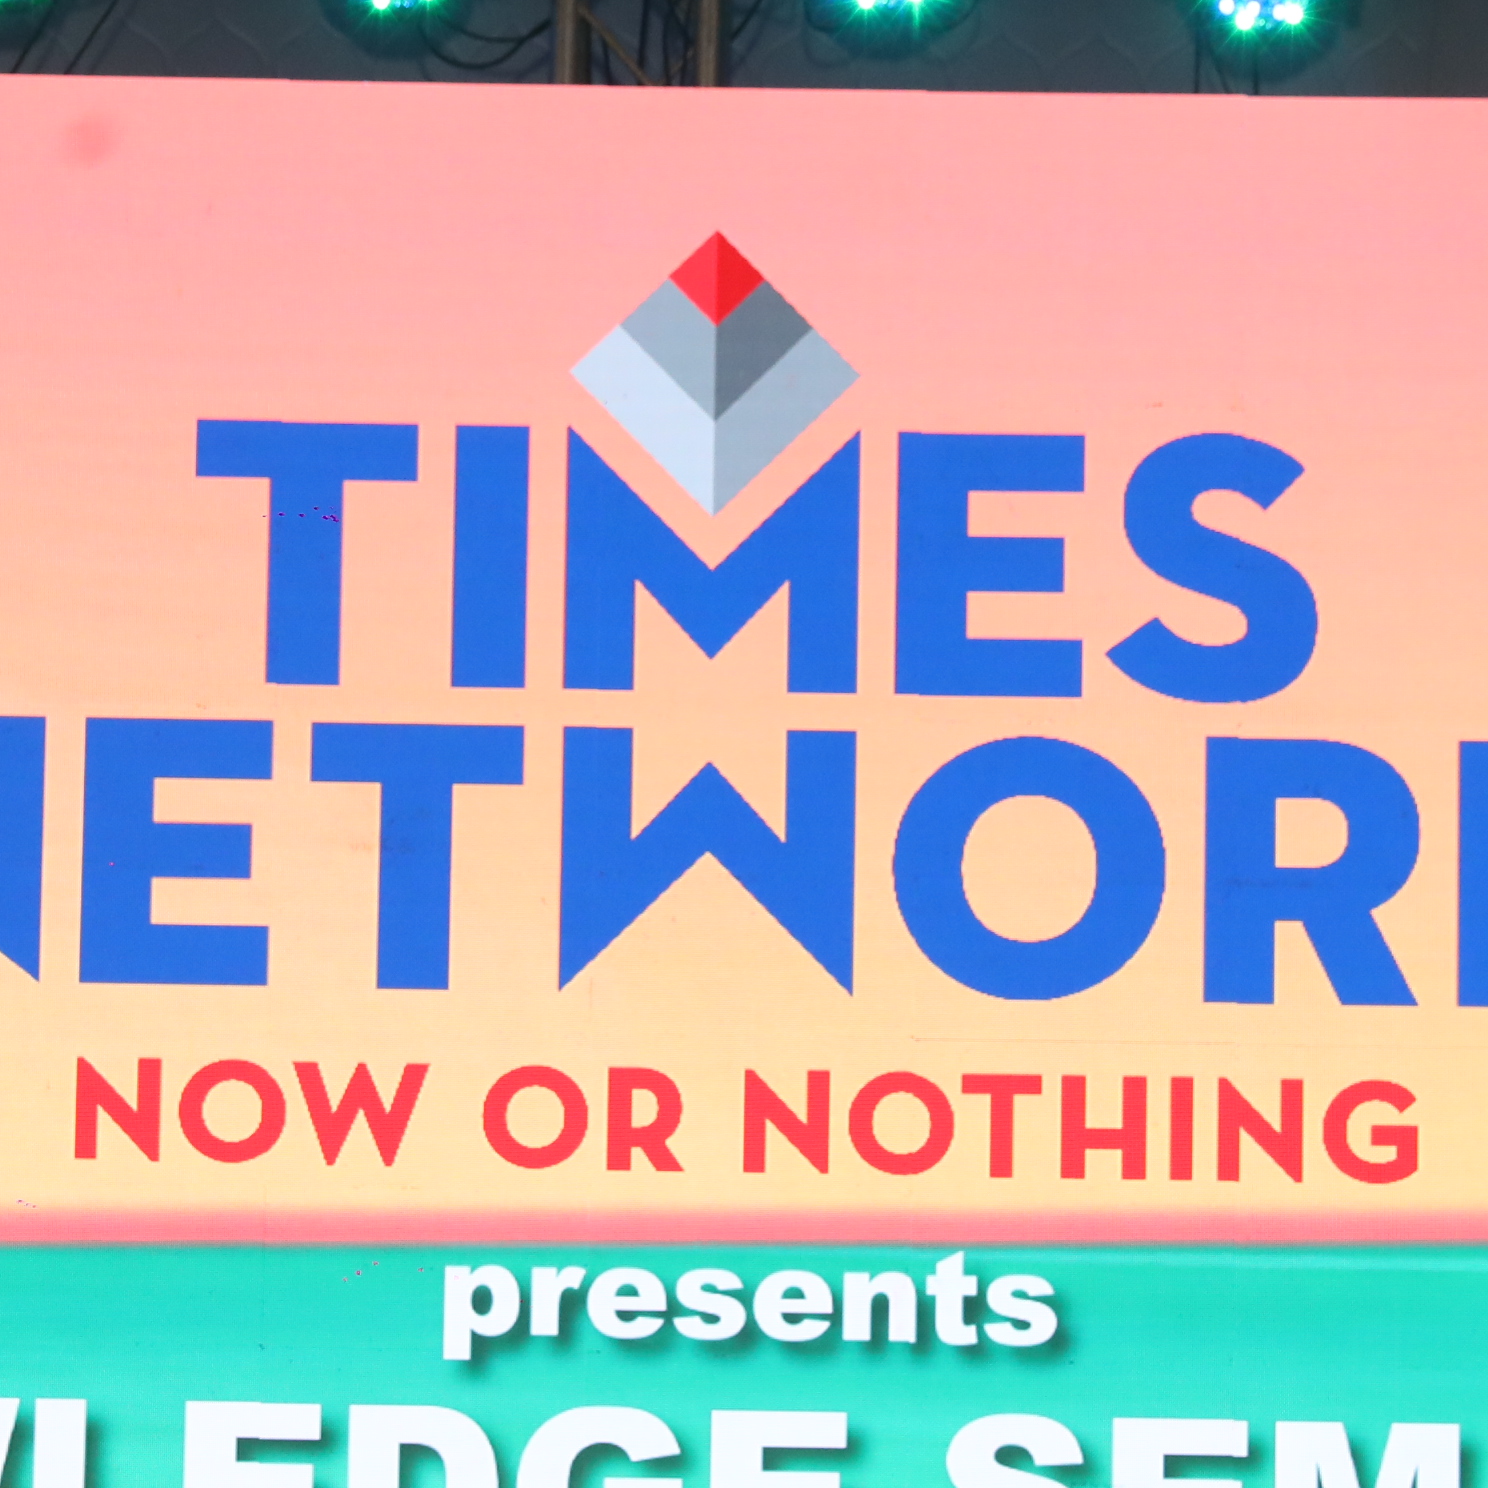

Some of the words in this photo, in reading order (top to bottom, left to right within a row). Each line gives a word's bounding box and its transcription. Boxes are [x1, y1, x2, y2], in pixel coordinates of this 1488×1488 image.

[197, 420, 1318, 703] TIMES
[73, 1056, 430, 1167] NOW
[483, 1065, 684, 1172] OR
[742, 1069, 1419, 1184] NOTHING
[442, 1250, 1058, 1361] presents
